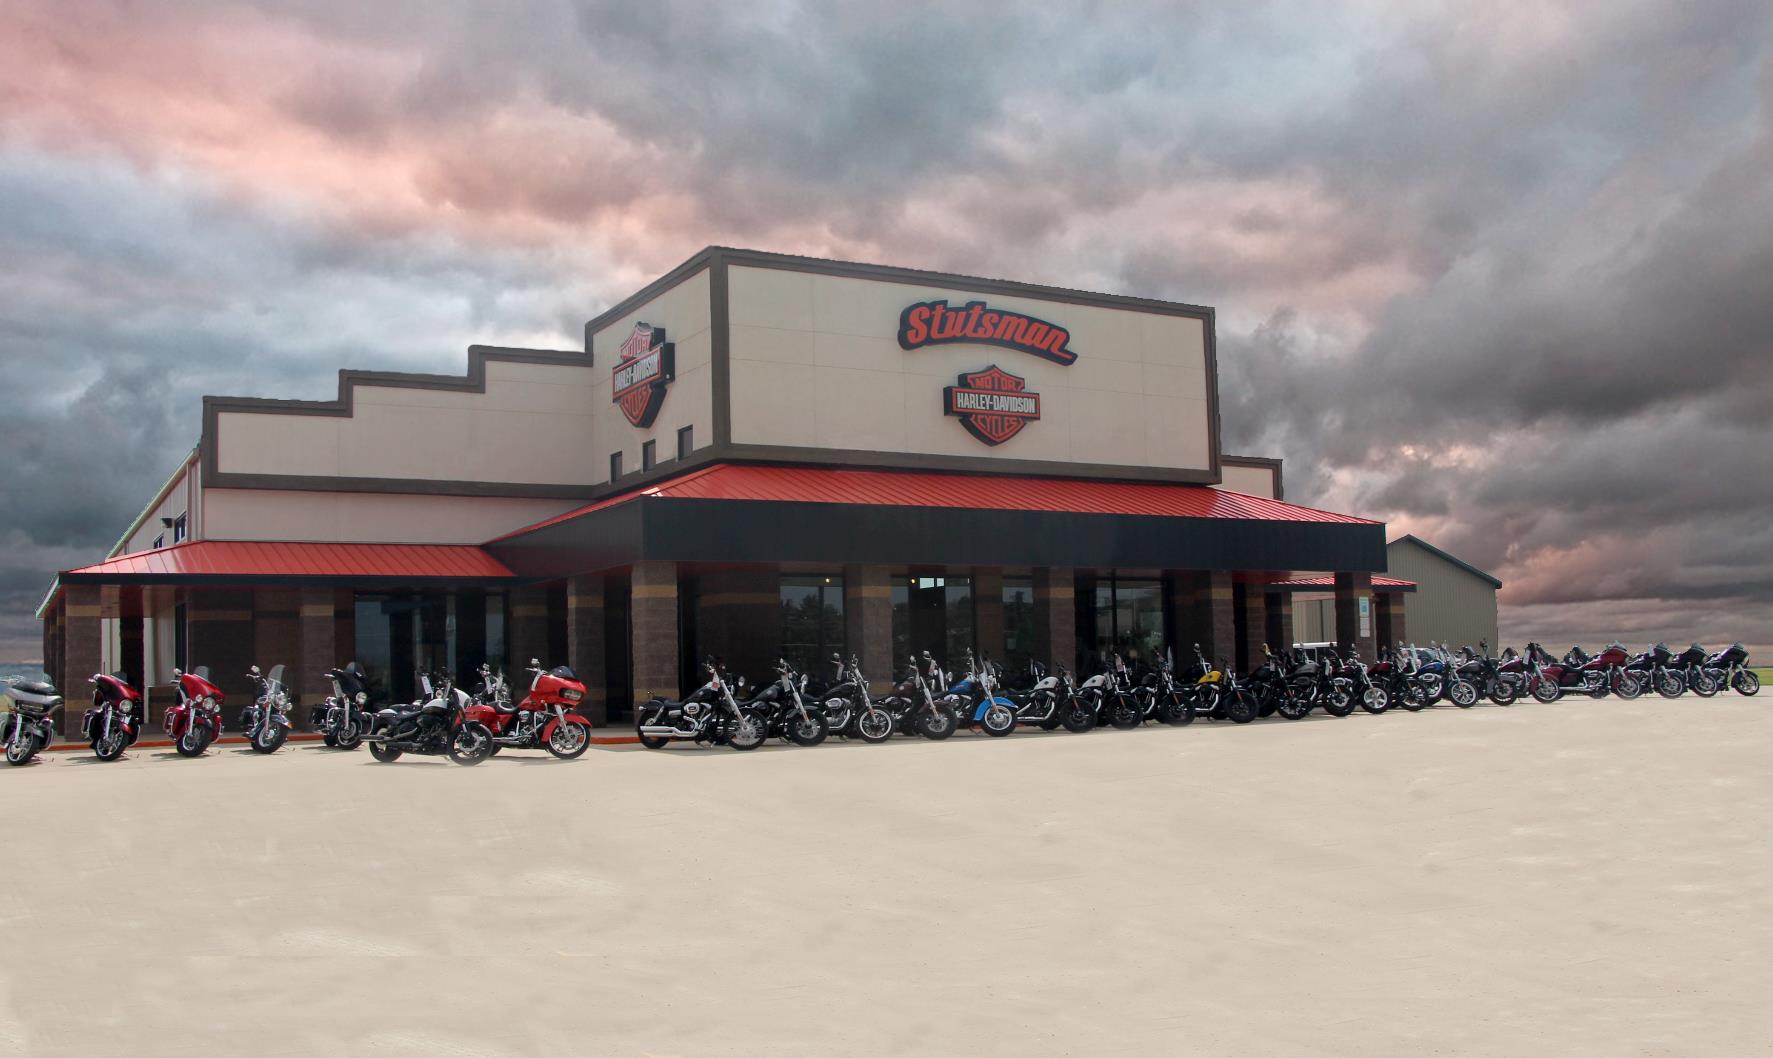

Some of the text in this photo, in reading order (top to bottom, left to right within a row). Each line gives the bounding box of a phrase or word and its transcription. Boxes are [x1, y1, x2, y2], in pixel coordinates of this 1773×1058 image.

[906, 303, 1073, 360] Stutsman
[975, 373, 1017, 391] MOTOR
[956, 392, 1036, 413] HARLEY-DAVIDSON
[977, 414, 1018, 436] CYCLES
